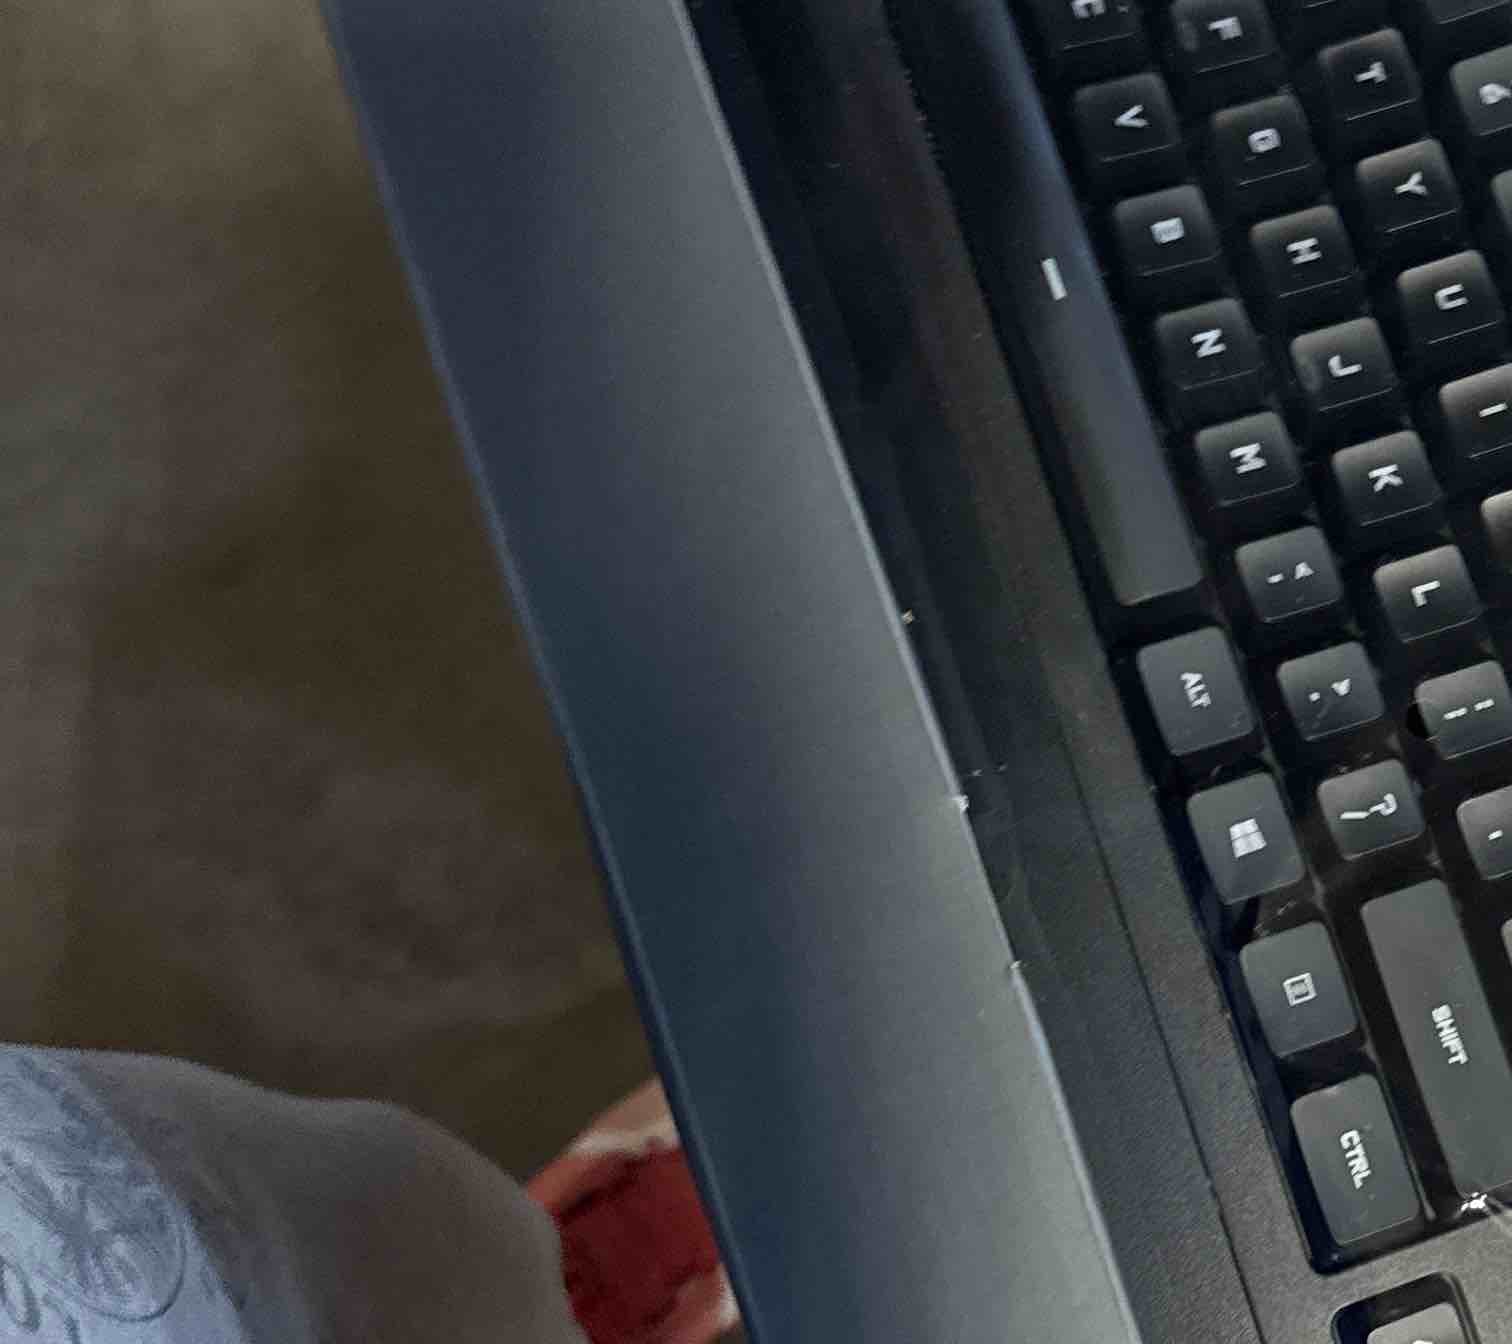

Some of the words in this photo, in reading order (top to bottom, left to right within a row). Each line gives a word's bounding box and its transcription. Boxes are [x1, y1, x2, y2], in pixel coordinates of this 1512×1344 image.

[1208, 16, 1242, 40] F
[1356, 61, 1387, 83] T
[1479, 83, 1511, 105] 6
[1115, 104, 1148, 127] V
[1395, 171, 1426, 194] Y
[1286, 237, 1322, 265] H
[1434, 283, 1467, 310] U
[1191, 328, 1226, 358] N
[1327, 354, 1362, 377] J
[1229, 442, 1266, 474] M
[1368, 463, 1403, 492] K
[1411, 580, 1441, 607] L
[1180, 672, 1211, 707] ALT
[1431, 1004, 1468, 1065] SHIFT
[1340, 1129, 1371, 1189] CTRL
